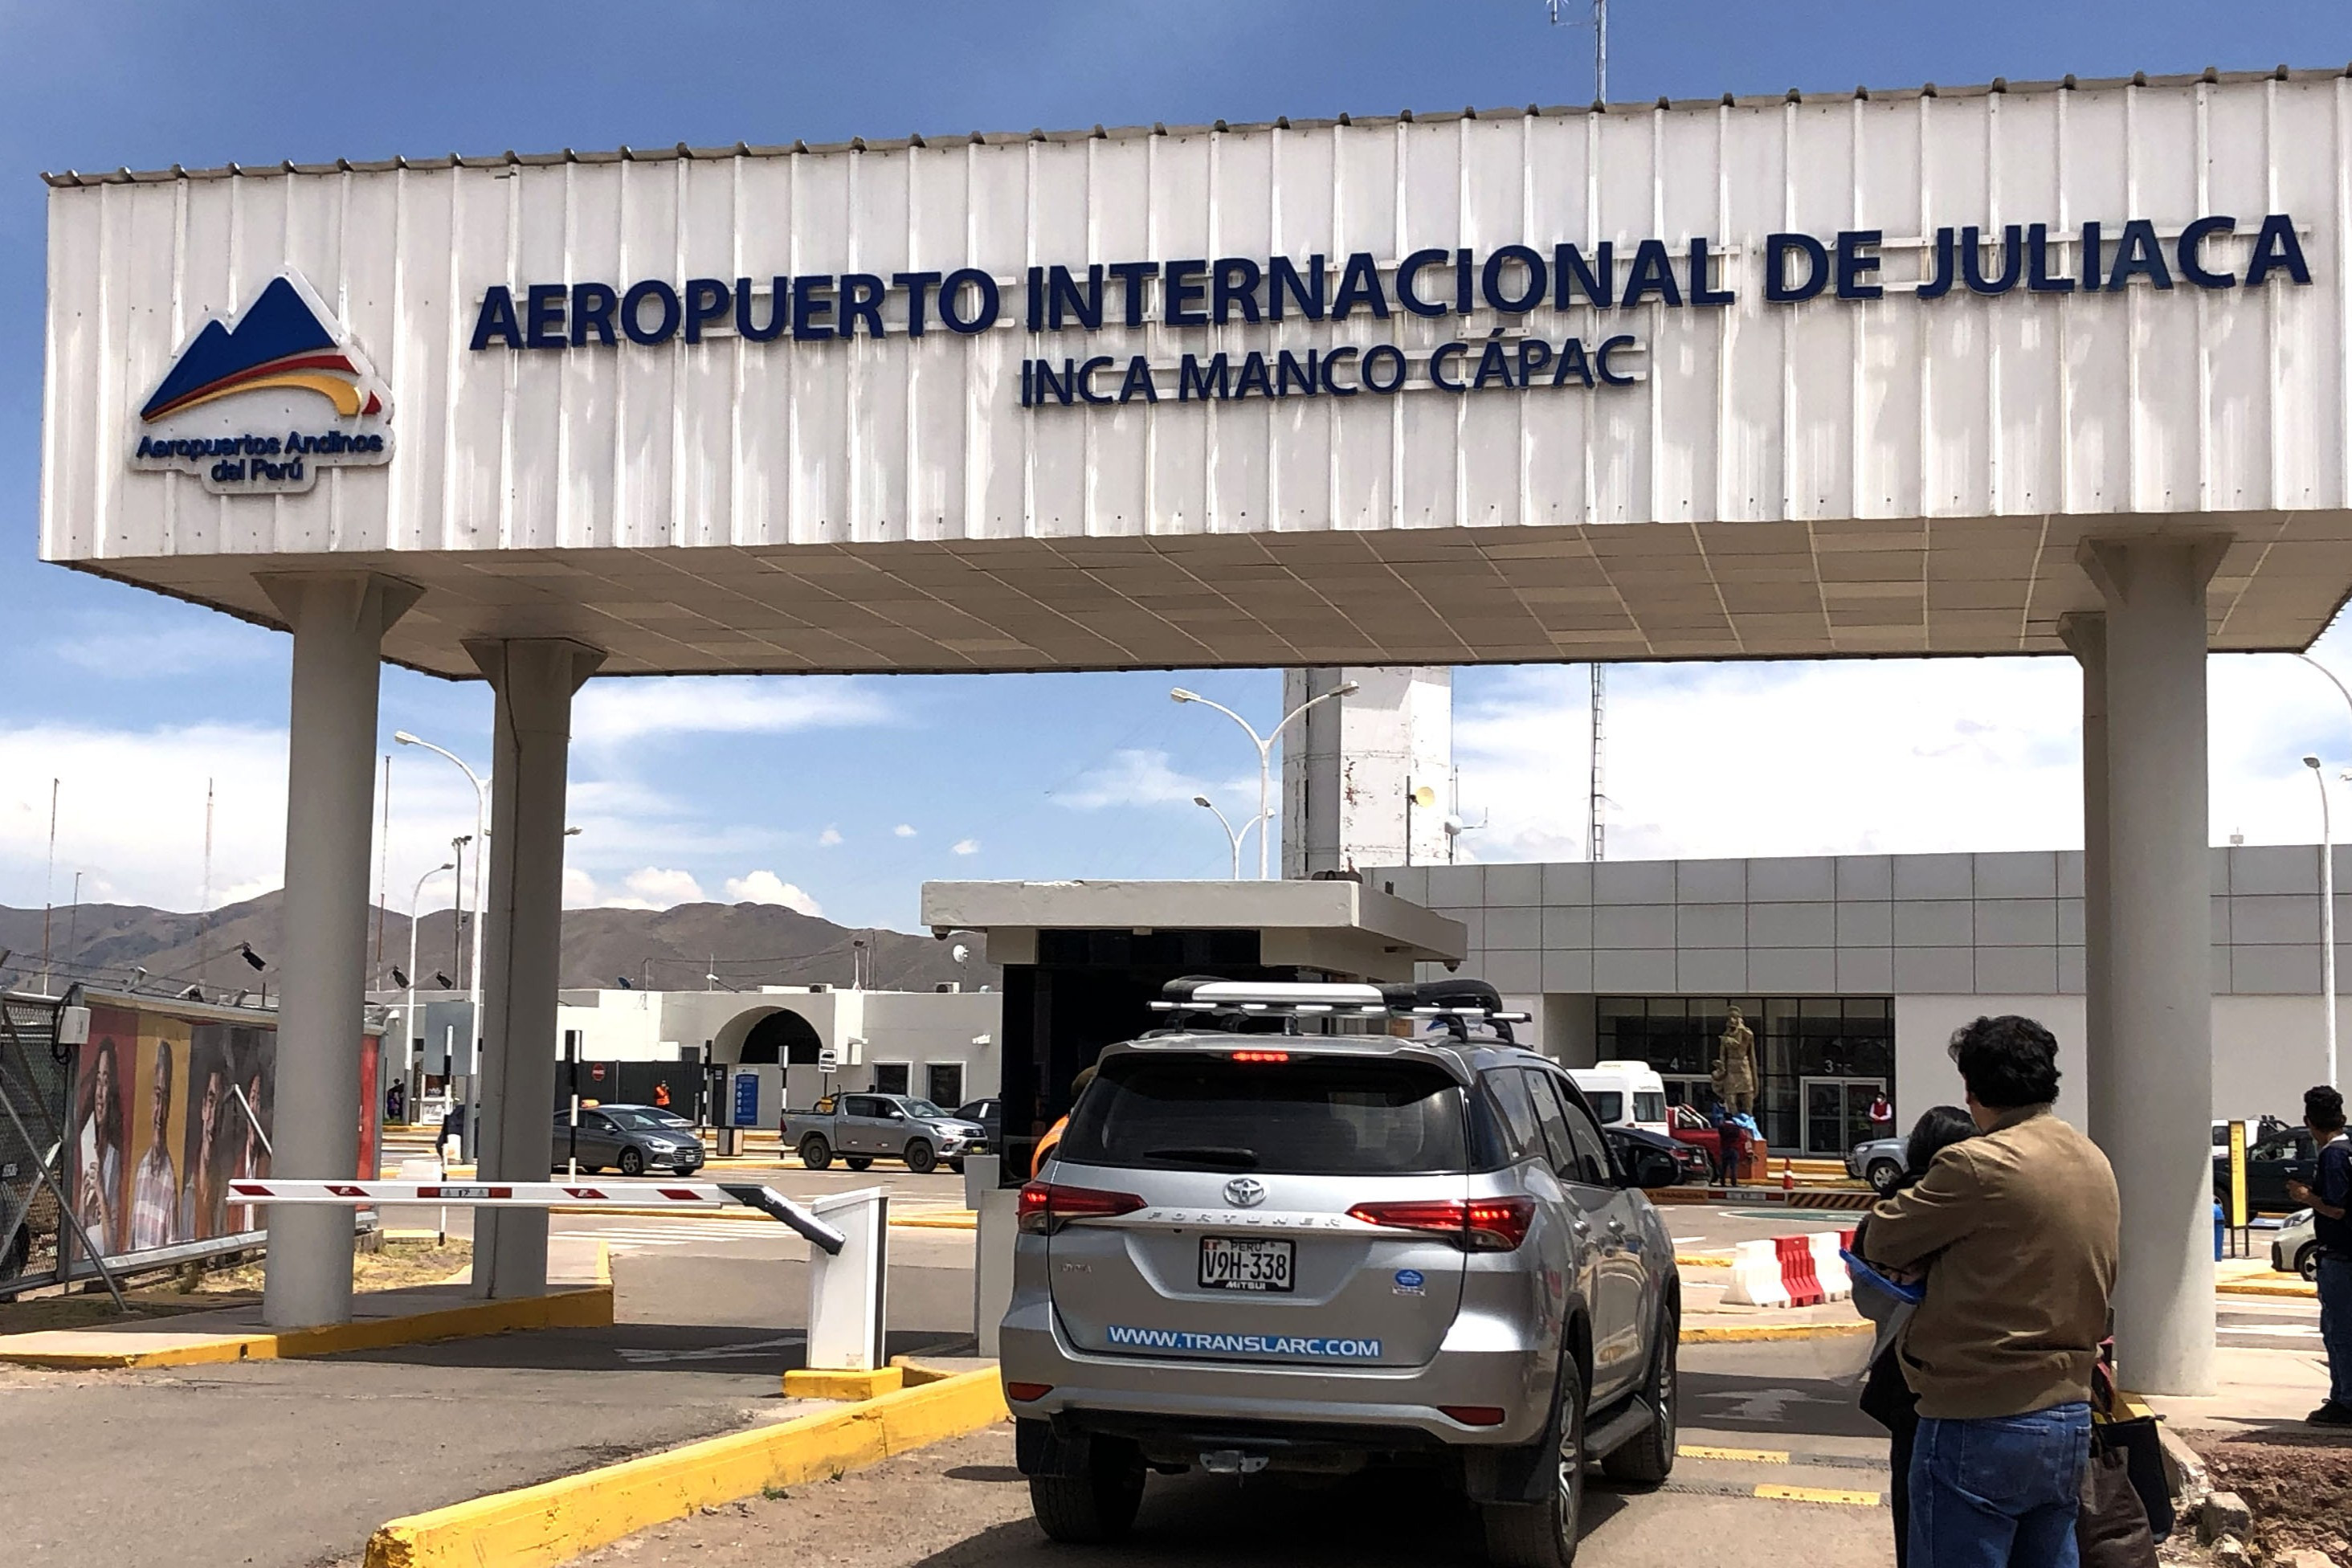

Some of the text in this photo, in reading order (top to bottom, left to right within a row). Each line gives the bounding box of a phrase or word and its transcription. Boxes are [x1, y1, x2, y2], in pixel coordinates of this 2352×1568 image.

[469, 213, 2313, 351] AEROPUERTO INTERNACIONAL DE JULIACA
[1021, 327, 1636, 408] INCA MANCO CÁPAC
[136, 430, 384, 462] Aeropuertos Andinos
[210, 455, 304, 482] del Perú
[1669, 1056, 1680, 1072] 4
[1824, 1059, 1834, 1073] 3
[1147, 1211, 1341, 1227] FORTUNER
[1230, 1242, 1263, 1252] PERU
[1204, 1250, 1288, 1281] V9H-338
[1109, 1325, 1380, 1358] WWW.TRANSLARC.COM
